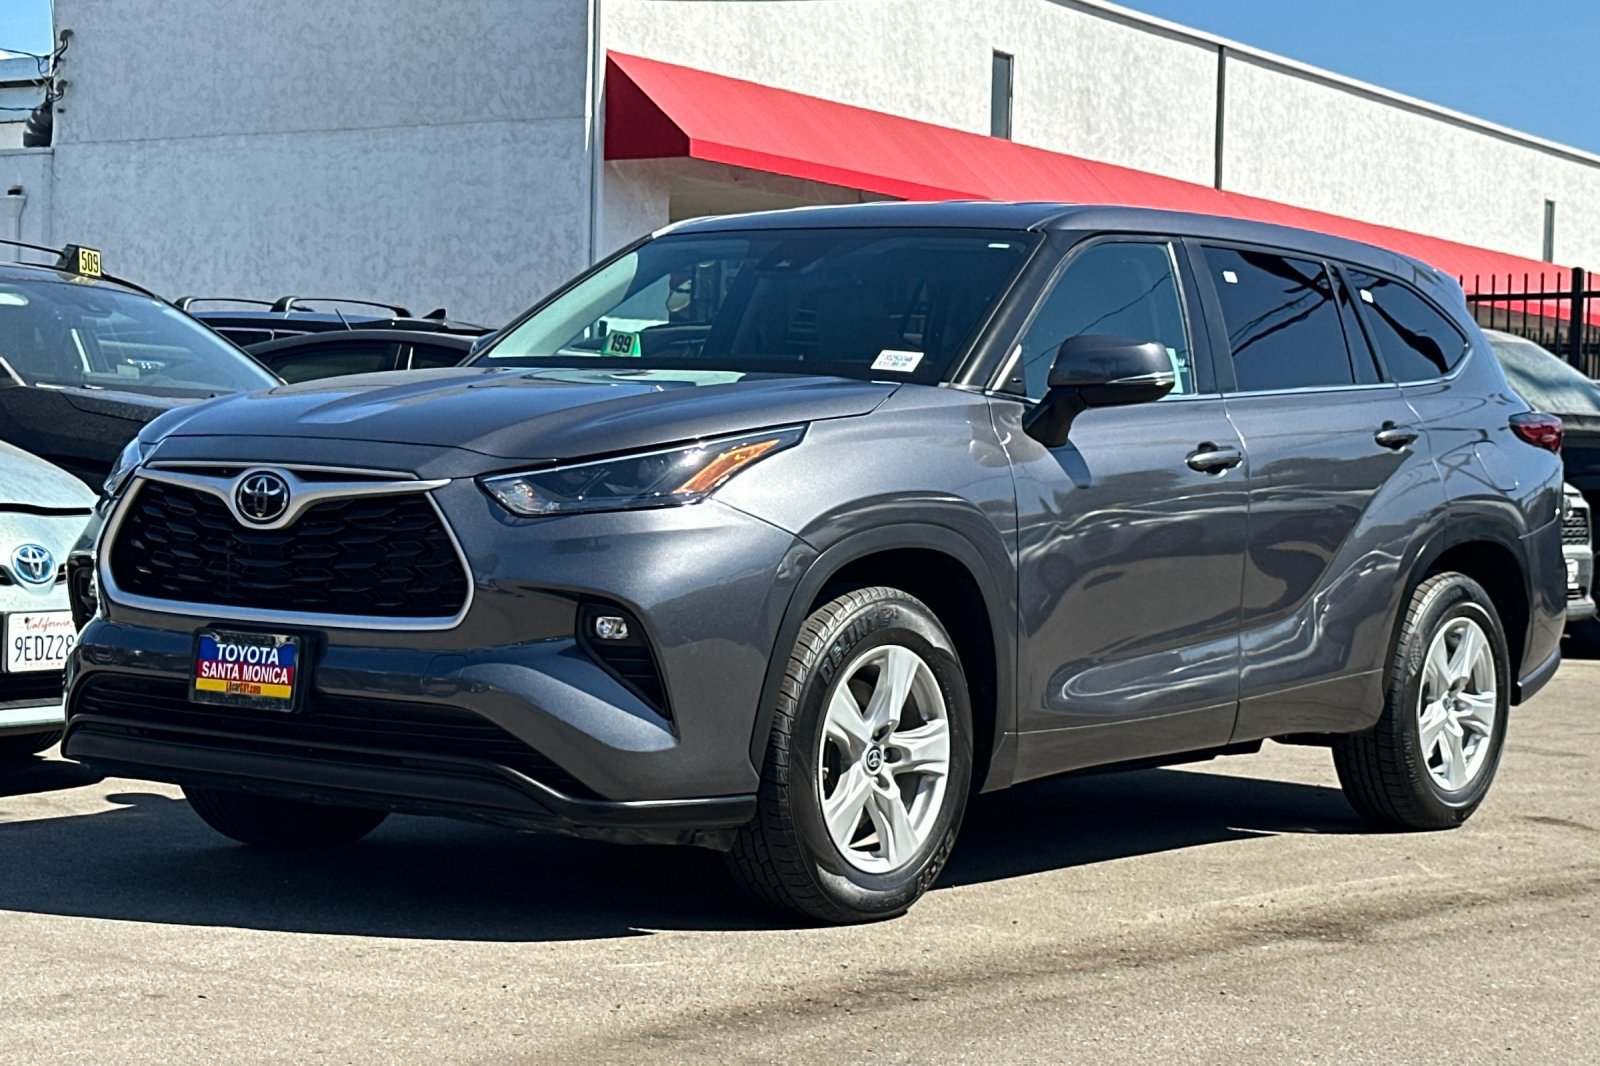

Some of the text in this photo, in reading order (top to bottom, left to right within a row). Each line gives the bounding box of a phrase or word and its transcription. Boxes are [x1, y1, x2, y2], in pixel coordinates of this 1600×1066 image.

[81, 251, 99, 273] 509
[611, 333, 632, 354] 199
[24, 616, 72, 632] California
[216, 643, 280, 665] TOYOTA
[201, 661, 289, 684] SANTA MONICA
